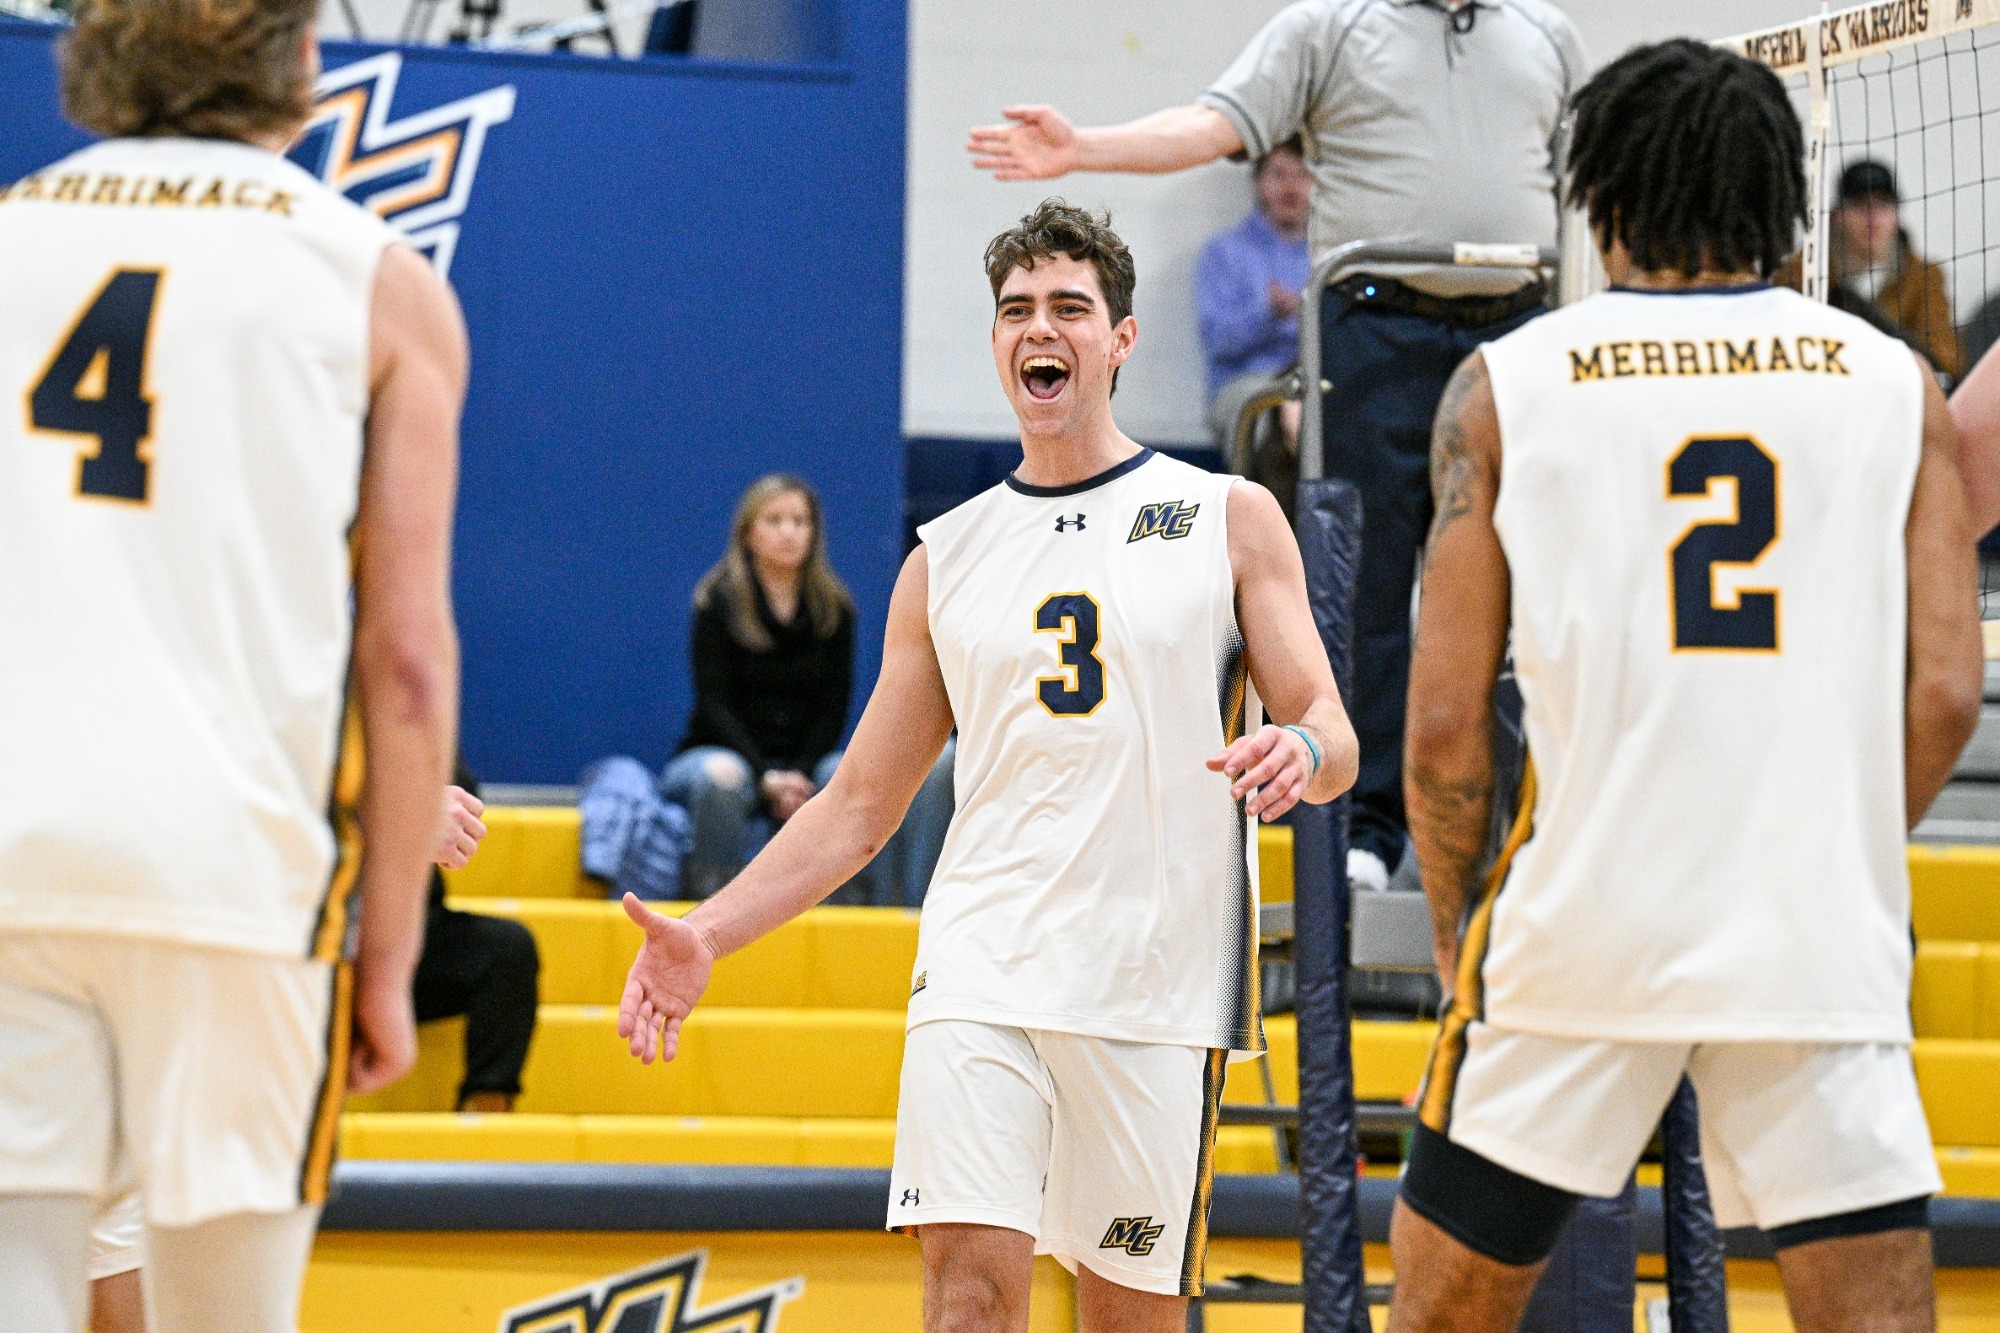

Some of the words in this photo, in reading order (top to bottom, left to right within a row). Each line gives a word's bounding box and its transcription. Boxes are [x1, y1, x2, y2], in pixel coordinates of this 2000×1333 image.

[23, 264, 168, 511] 4
[1568, 336, 1851, 383] MERRIMACK
[1126, 499, 1200, 544] MC
[1664, 432, 1782, 654] 2
[1033, 590, 1107, 718] 3
[1100, 1216, 1165, 1256] MC
